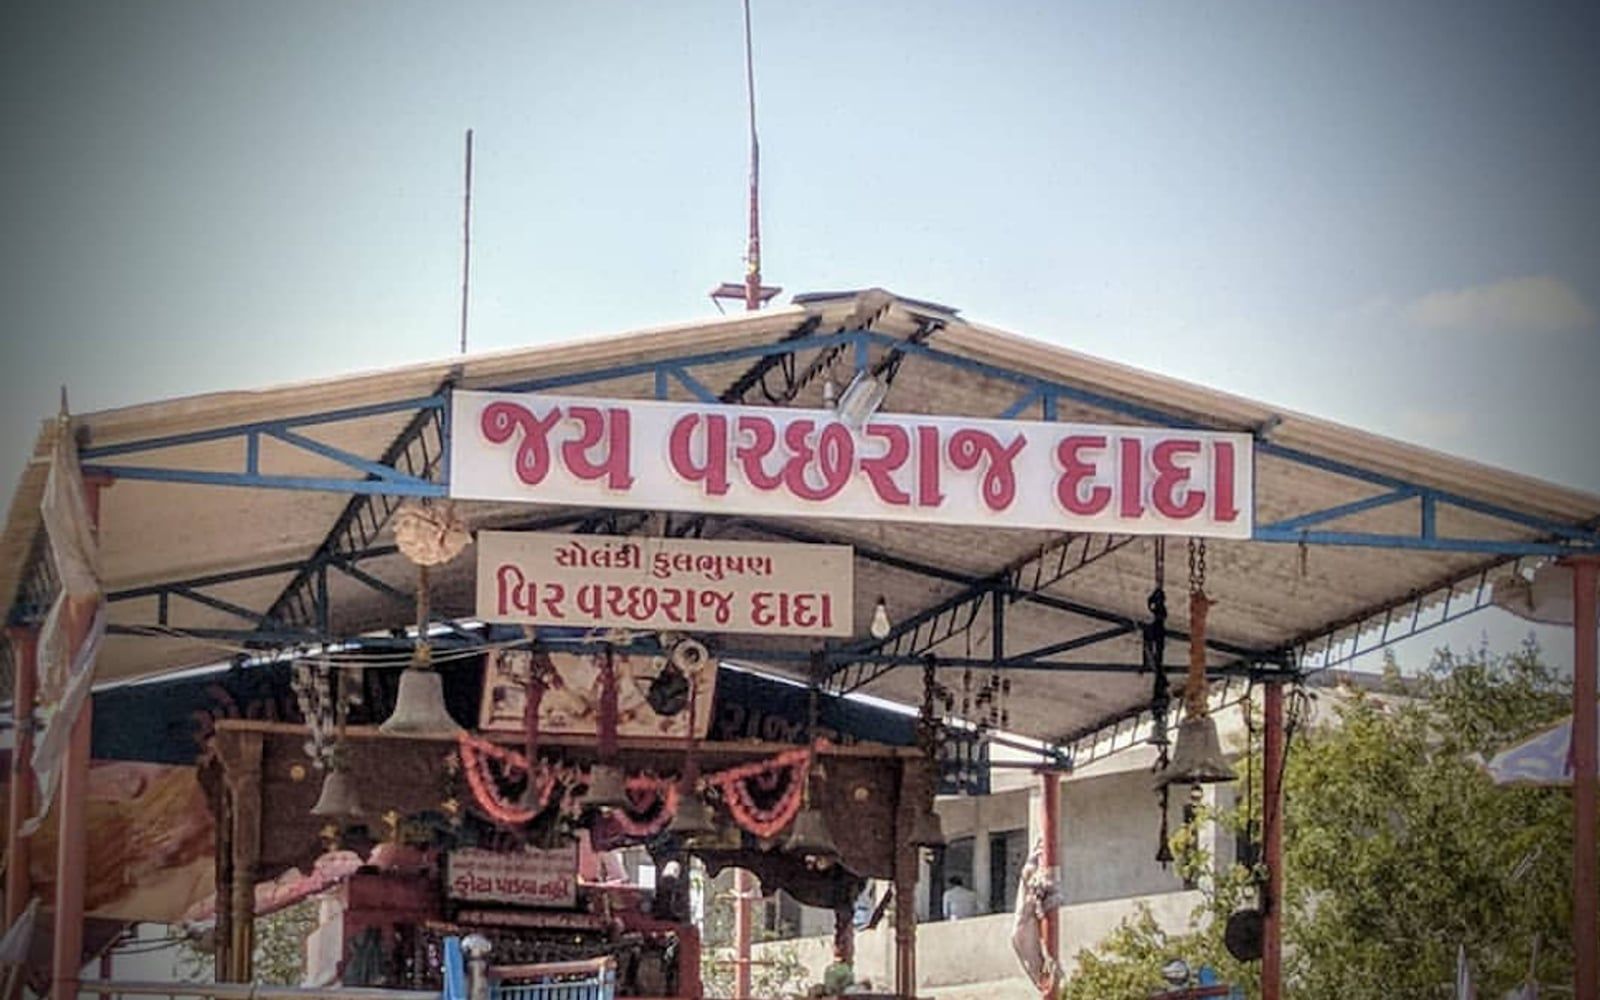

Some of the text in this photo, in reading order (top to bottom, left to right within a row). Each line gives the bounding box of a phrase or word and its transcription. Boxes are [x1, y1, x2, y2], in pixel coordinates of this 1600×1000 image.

[480, 402, 1240, 522] જય વચ્છરાજ દાદા
[555, 541, 641, 569] સોલંકી
[496, 564, 832, 628] વિર વચ્છરાજ દાદા
